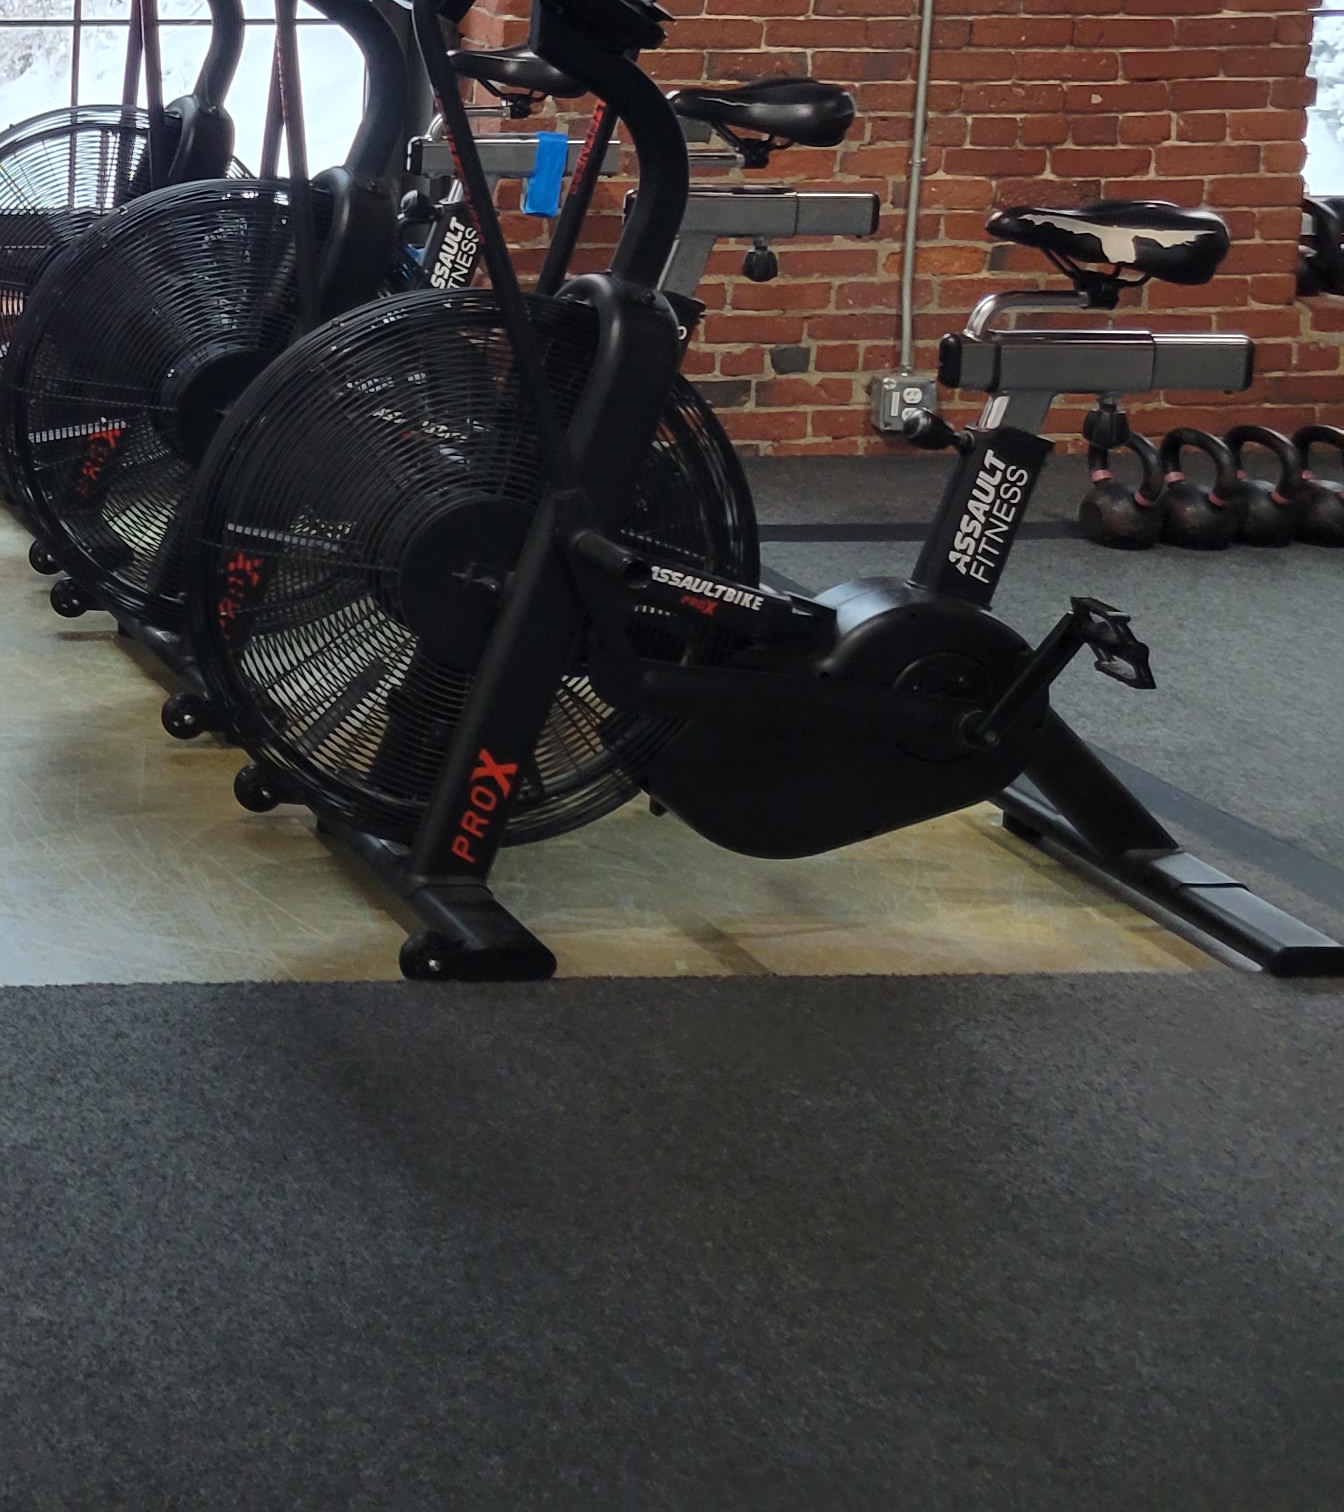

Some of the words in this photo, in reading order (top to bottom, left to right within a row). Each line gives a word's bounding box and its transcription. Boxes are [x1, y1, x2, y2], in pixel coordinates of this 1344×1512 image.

[430, 216, 465, 290] SSAULT
[447, 227, 479, 289] TNESS
[948, 448, 1006, 576] ASSAULT
[969, 465, 1028, 584] FITNESS
[451, 748, 519, 864] PROX
